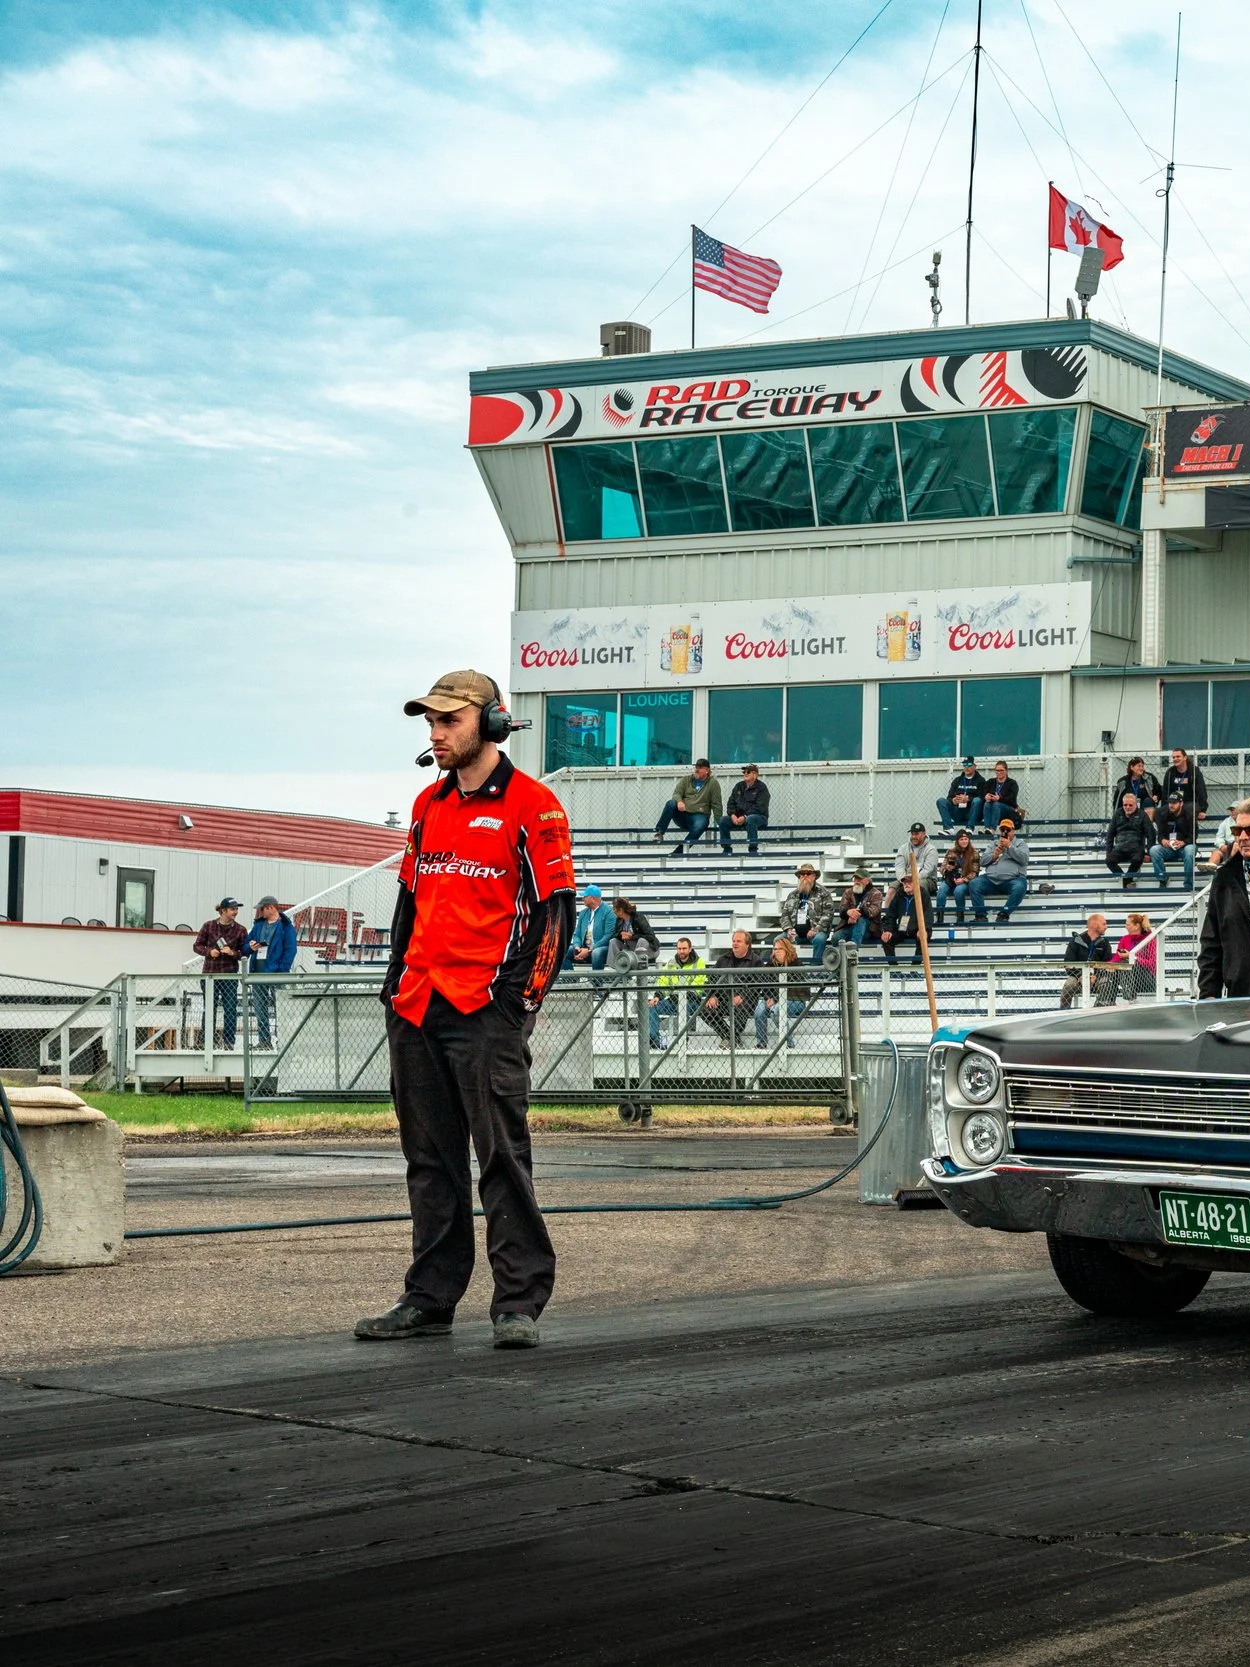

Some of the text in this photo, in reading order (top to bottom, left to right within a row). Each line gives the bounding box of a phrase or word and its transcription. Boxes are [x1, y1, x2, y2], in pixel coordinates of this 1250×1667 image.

[646, 379, 827, 407] RAD TORQUE
[639, 389, 882, 429] RACEWAY
[1180, 445, 1232, 464] MACH
[724, 633, 788, 660] Coors
[791, 637, 846, 656] LIGHT
[948, 623, 1015, 651] Coors
[1018, 627, 1077, 647] LIGHT
[520, 641, 634, 668] Coors LIGHT
[628, 693, 689, 707] LOUNGE
[567, 714, 602, 727] OPEN
[418, 862, 507, 879] RACEWAY
[1168, 1229, 1210, 1240] ALBERTA
